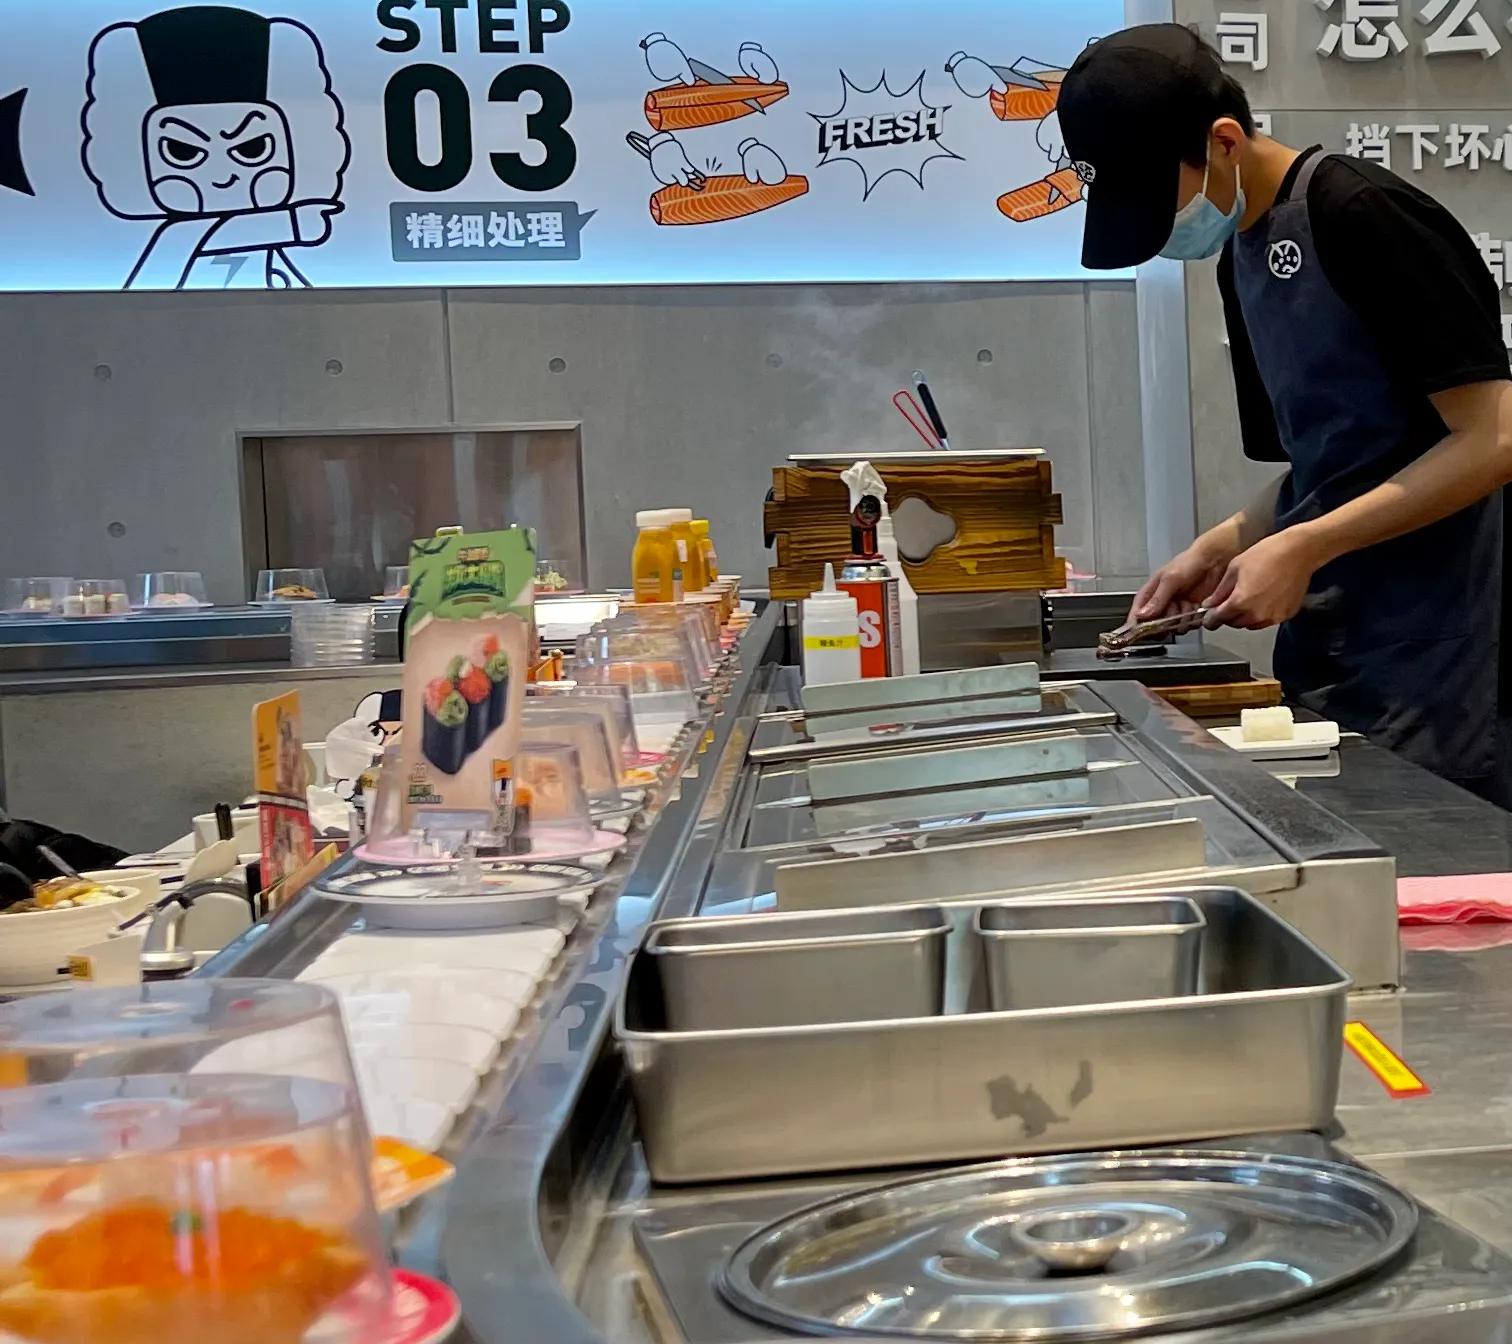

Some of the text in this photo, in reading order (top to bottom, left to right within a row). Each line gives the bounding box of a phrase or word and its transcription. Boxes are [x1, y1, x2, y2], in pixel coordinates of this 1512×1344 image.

[384, 63, 577, 192] 03
[818, 107, 945, 153] FRESH
[405, 210, 567, 251] 精细处理
